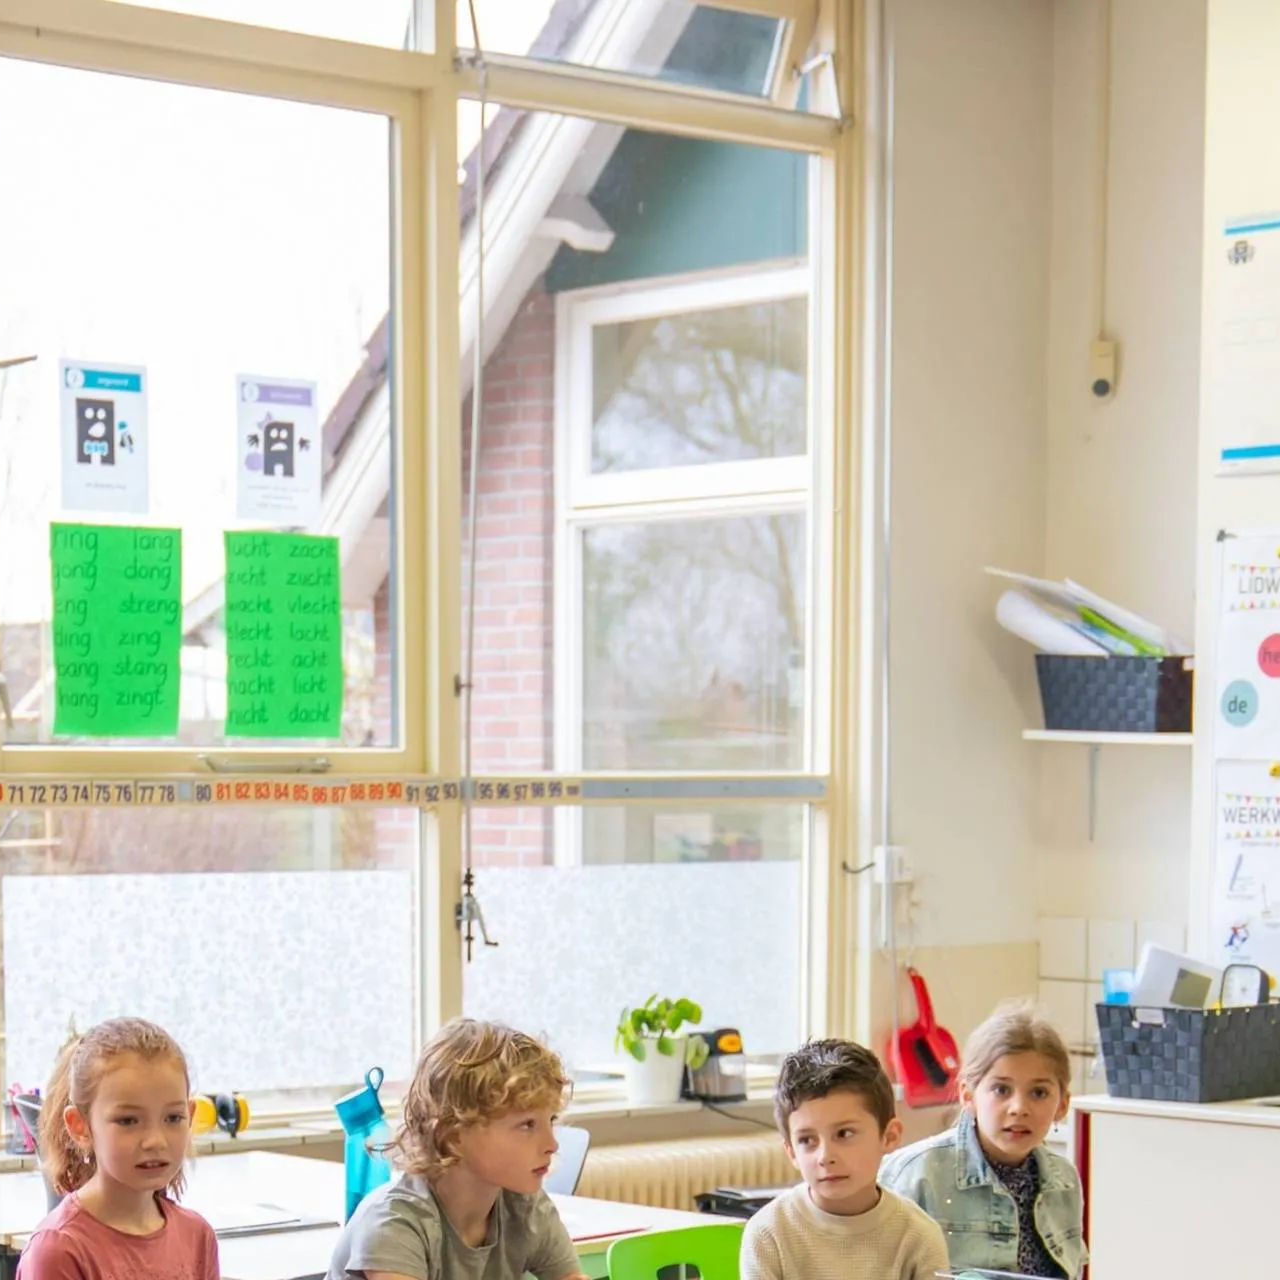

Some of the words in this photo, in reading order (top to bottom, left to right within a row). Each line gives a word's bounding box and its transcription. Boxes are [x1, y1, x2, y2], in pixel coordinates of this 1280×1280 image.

[119, 592, 179, 625] streng
[119, 630, 161, 657] zing
[114, 654, 168, 687] stang
[1228, 695, 1248, 714] de
[8, 785, 25, 803] 71
[29, 784, 47, 803] 72
[51, 784, 68, 802] 73
[73, 783, 90, 803] 74
[95, 784, 111, 802] 75
[115, 783, 132, 802] 76
[139, 786, 155, 803] 77
[158, 784, 175, 802] 78
[196, 783, 212, 801] 80
[216, 783, 231, 800] 81
[235, 783, 250, 799] 82
[255, 783, 270, 799] 83
[274, 783, 289, 799] 84
[332, 786, 346, 803] 87
[387, 782, 402, 799] 90
[406, 785, 420, 801] 91
[425, 784, 440, 801] 92
